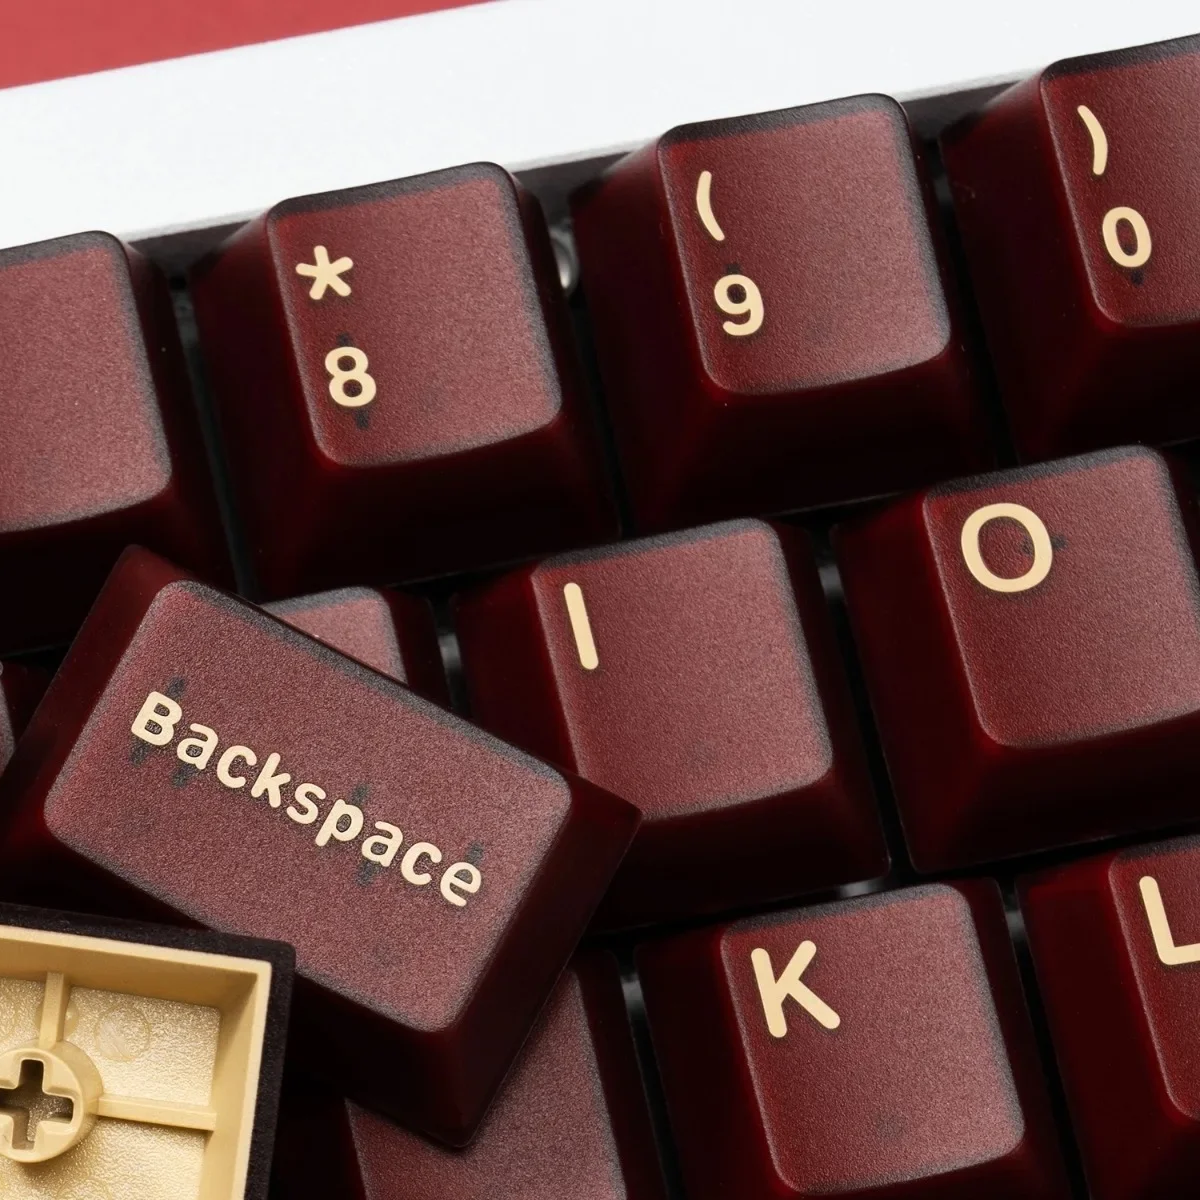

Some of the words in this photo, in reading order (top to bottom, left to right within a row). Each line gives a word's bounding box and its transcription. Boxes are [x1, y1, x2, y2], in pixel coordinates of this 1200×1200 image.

[1077, 105, 1109, 176] )
[695, 170, 726, 242] (
[1102, 206, 1153, 269] 0
[713, 274, 766, 337] 9
[324, 346, 377, 408] 8
[960, 502, 1054, 593] O
[129, 690, 484, 911] Backspace
[1138, 875, 1200, 967] L
[750, 940, 842, 1038] K
